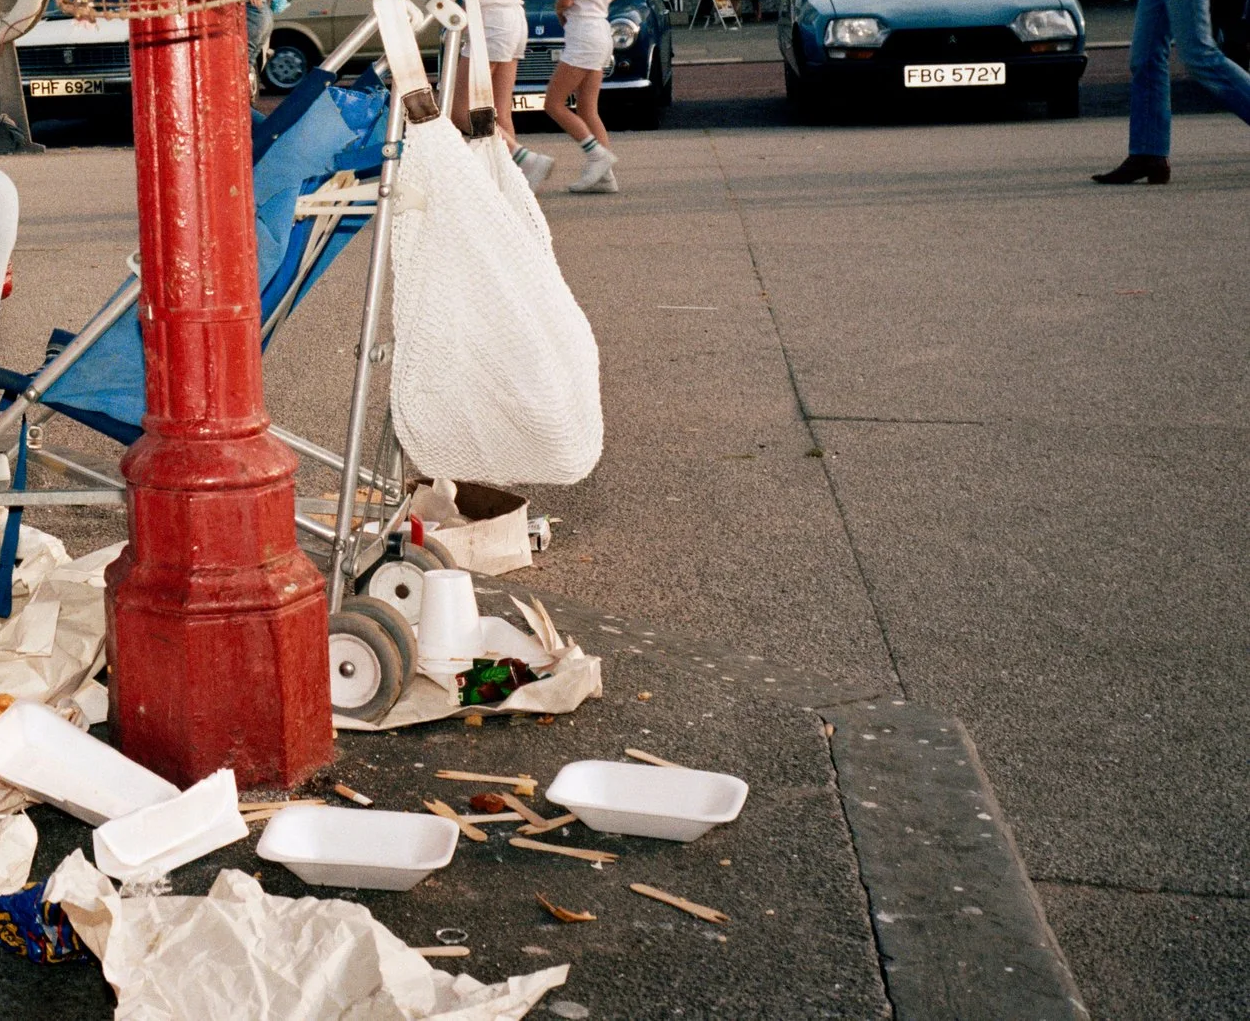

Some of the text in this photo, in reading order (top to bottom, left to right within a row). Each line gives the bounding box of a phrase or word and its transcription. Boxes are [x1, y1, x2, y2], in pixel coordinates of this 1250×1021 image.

[907, 66, 1002, 83] FBG 572Y
[31, 80, 103, 95] PHF 692M
